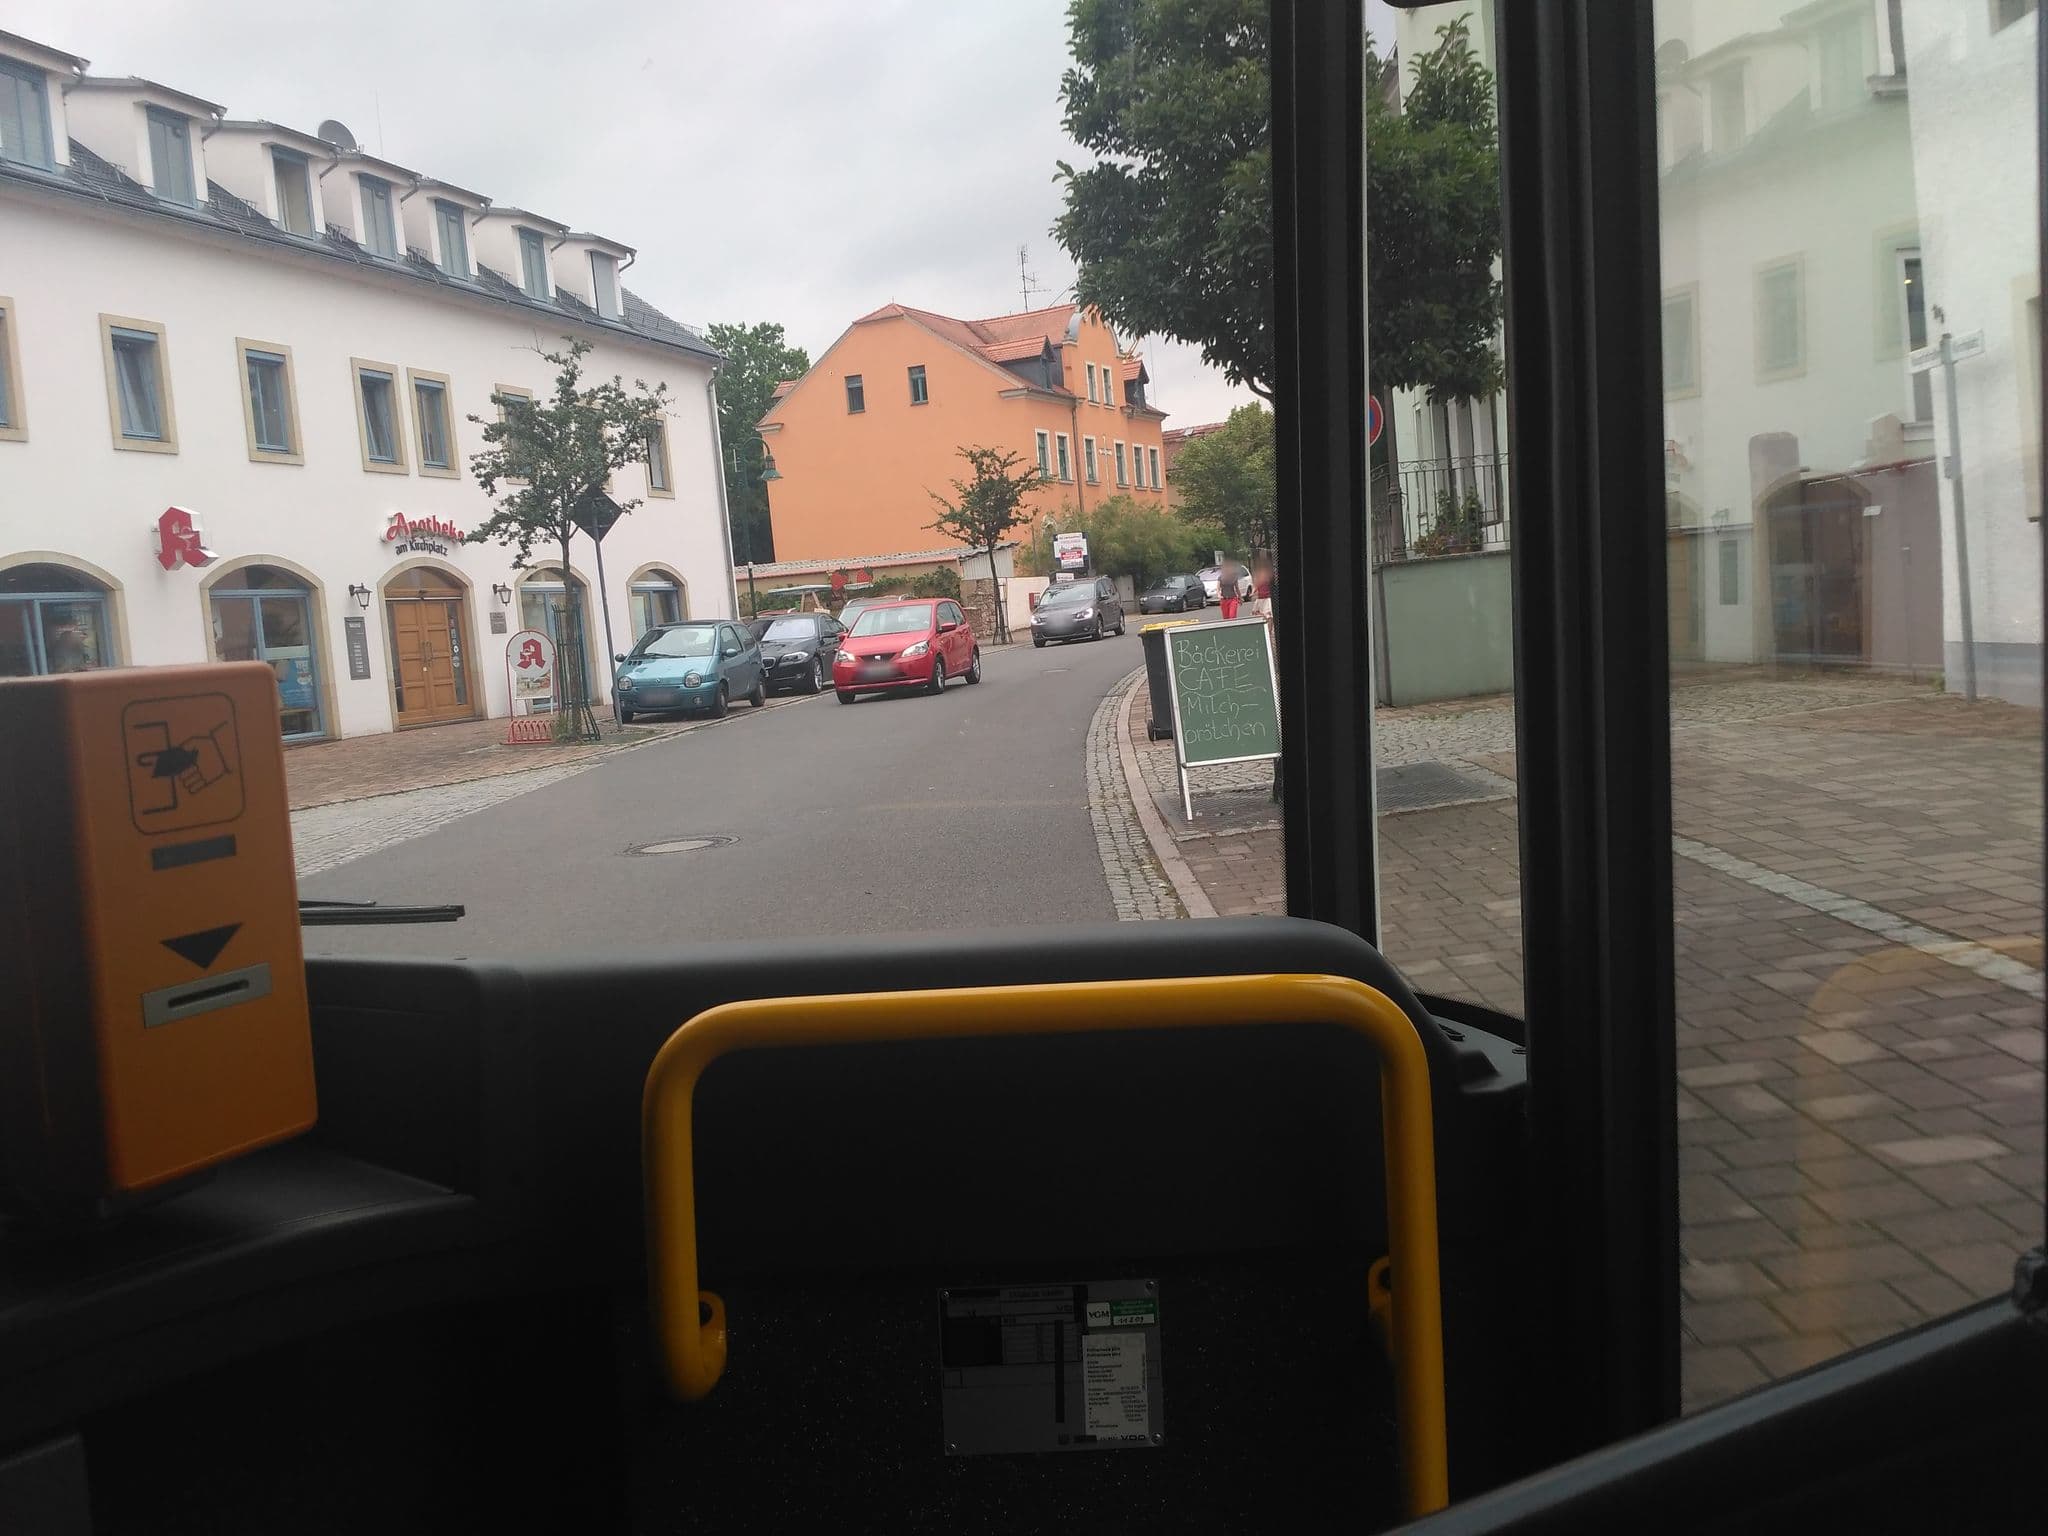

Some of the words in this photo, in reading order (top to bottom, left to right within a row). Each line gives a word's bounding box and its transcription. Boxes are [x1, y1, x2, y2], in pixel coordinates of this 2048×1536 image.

[386, 512, 465, 541] Apotheke
[395, 542, 408, 555] am
[409, 538, 448, 556] Kirchplatz
[1175, 635, 1259, 668] Bäckerei
